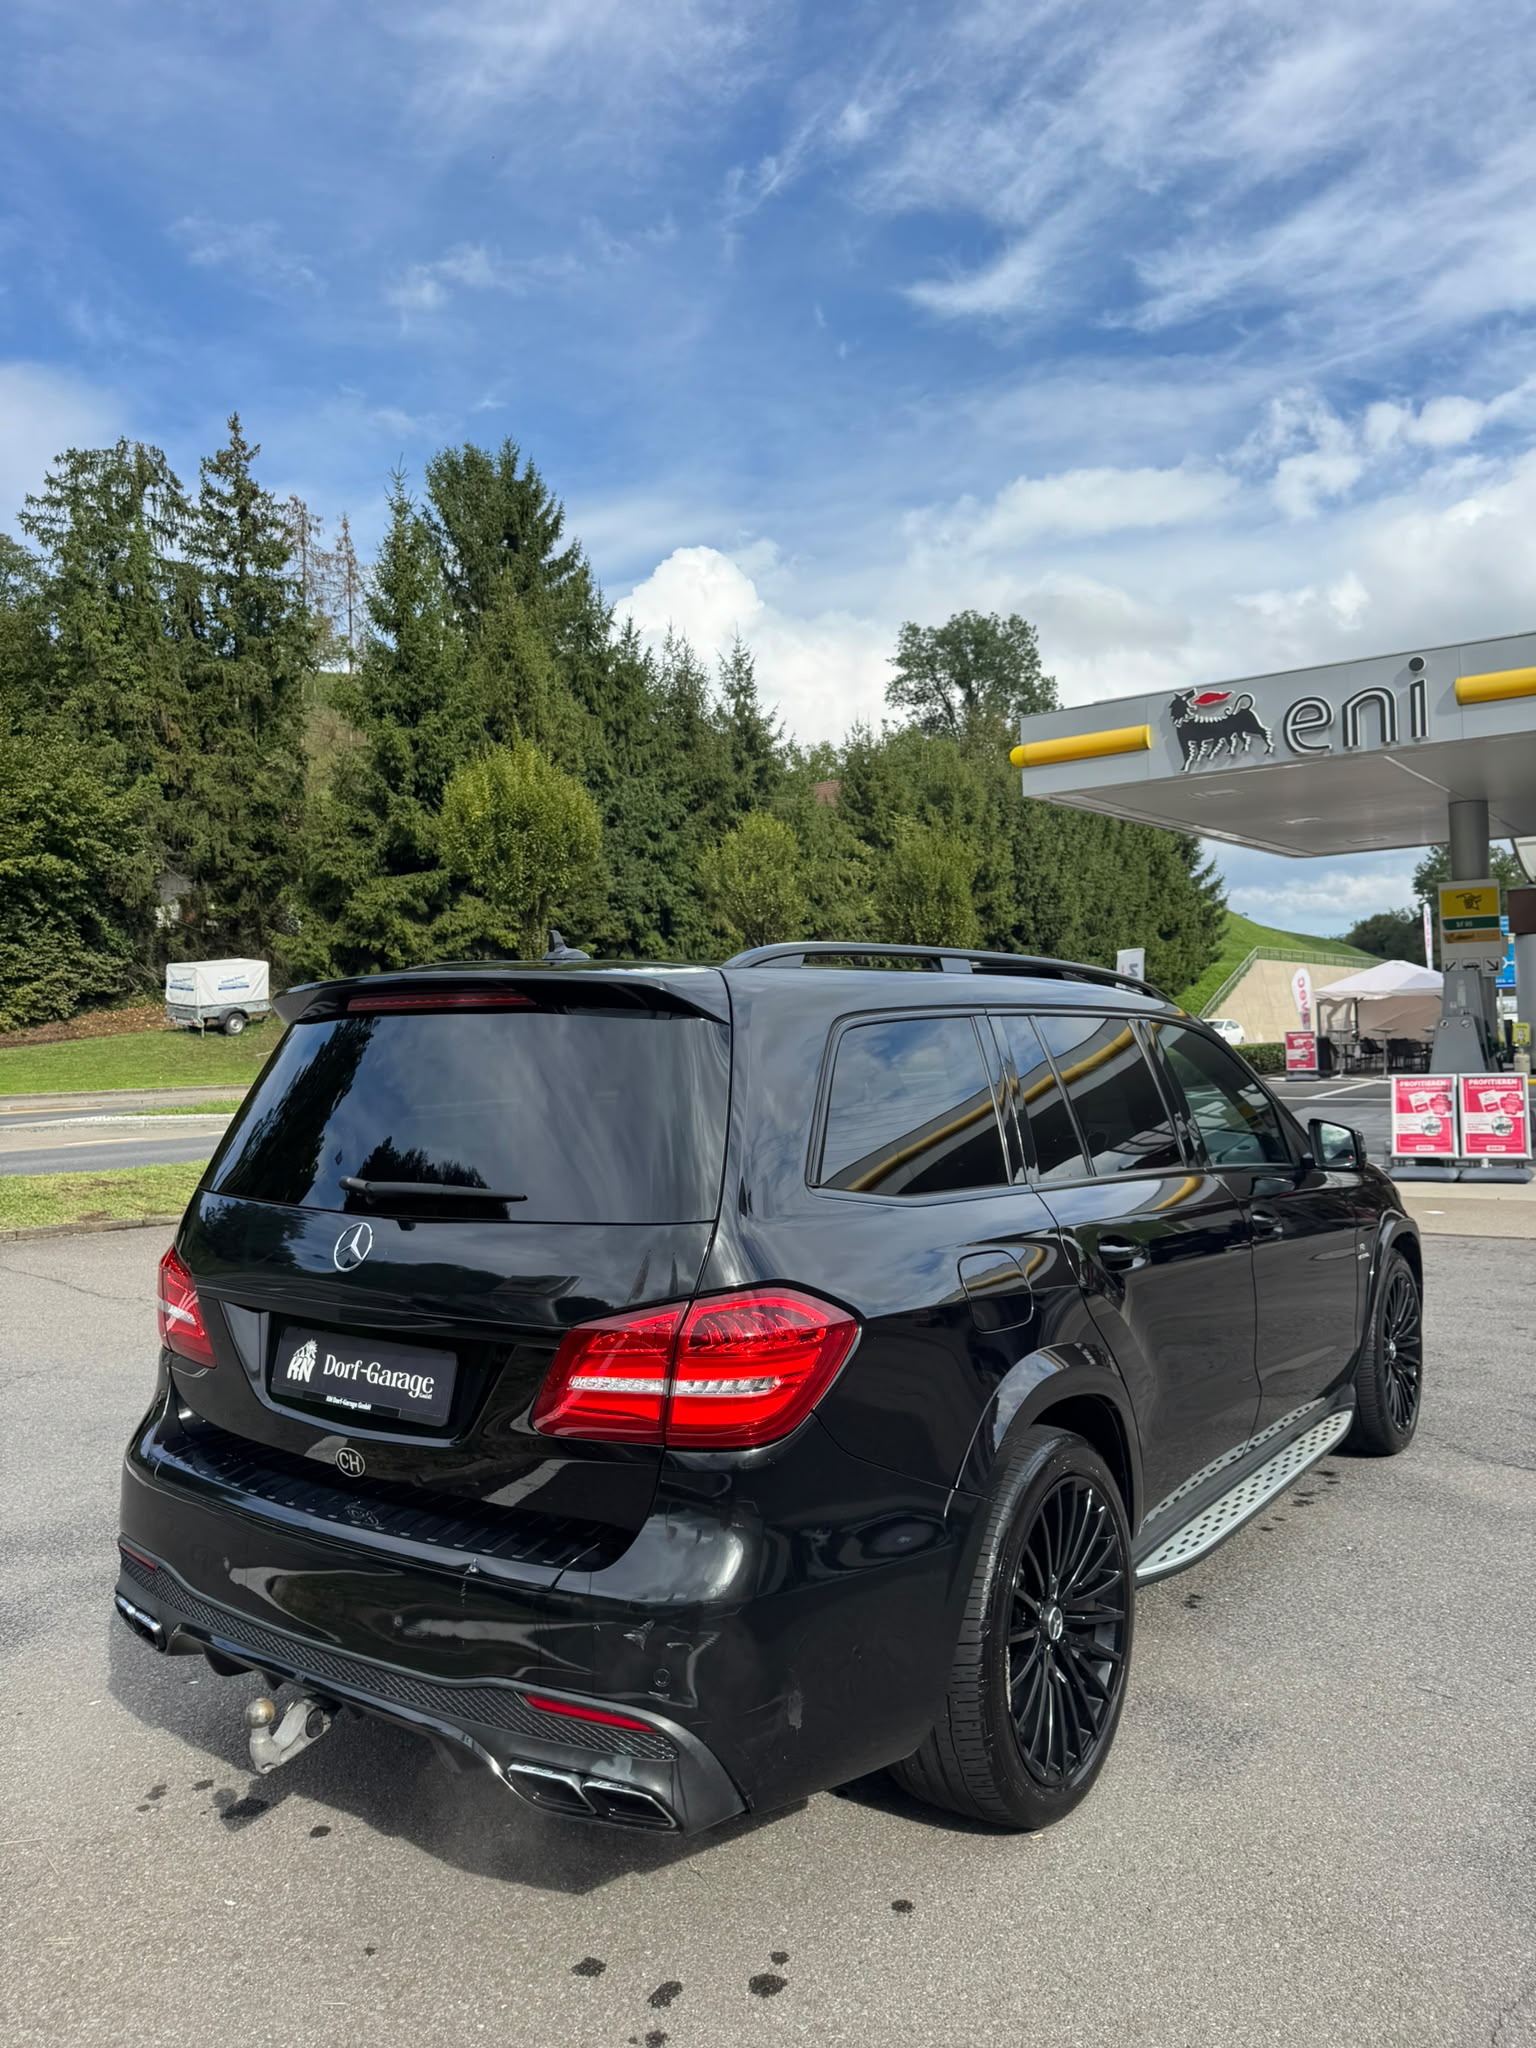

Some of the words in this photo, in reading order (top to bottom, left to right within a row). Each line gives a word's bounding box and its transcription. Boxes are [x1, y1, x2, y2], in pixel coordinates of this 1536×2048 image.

[1282, 656, 1430, 754] eni
[1399, 1079, 1446, 1088] PROFITIEREN
[1468, 1078, 1518, 1086] PROFITIEREN
[287, 1355, 316, 1383] KN
[323, 1353, 435, 1398] Dorf-Garage
[332, 1396, 358, 1410] Dorf-Garage
[358, 1401, 373, 1411] GmbH
[338, 1451, 361, 1473] CH
